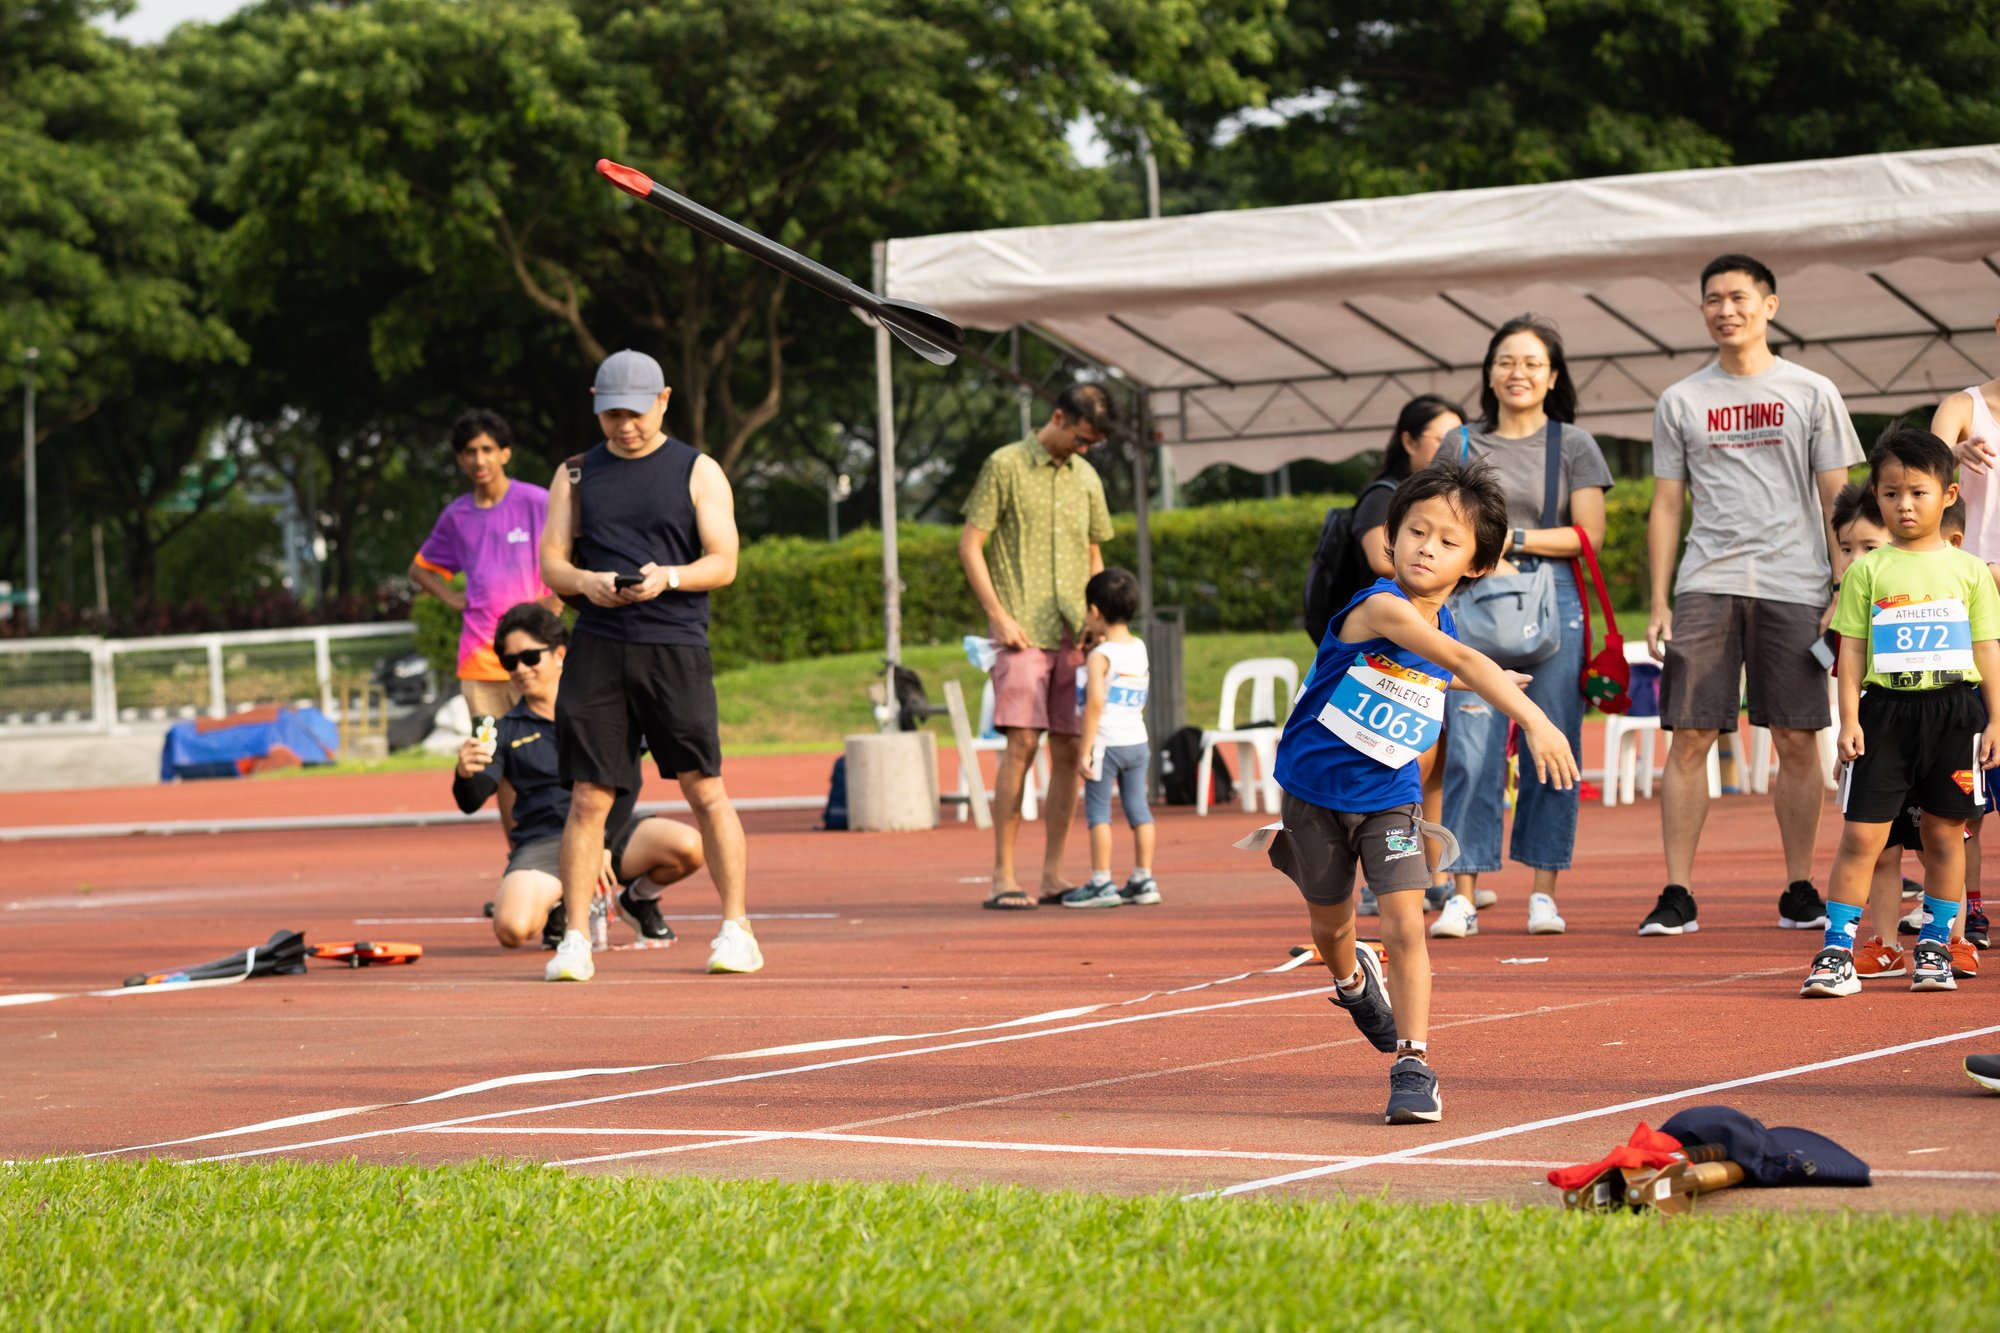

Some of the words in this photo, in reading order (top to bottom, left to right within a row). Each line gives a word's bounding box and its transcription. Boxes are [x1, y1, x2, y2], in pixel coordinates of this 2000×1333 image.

[1708, 402, 1784, 432] NOTHING
[1896, 608, 1949, 619] ATHLETICS
[1896, 625, 1950, 650] 872
[1376, 678, 1431, 709] ATHLETICS
[1348, 692, 1429, 746] 1063
[1875, 953, 1891, 967] N
